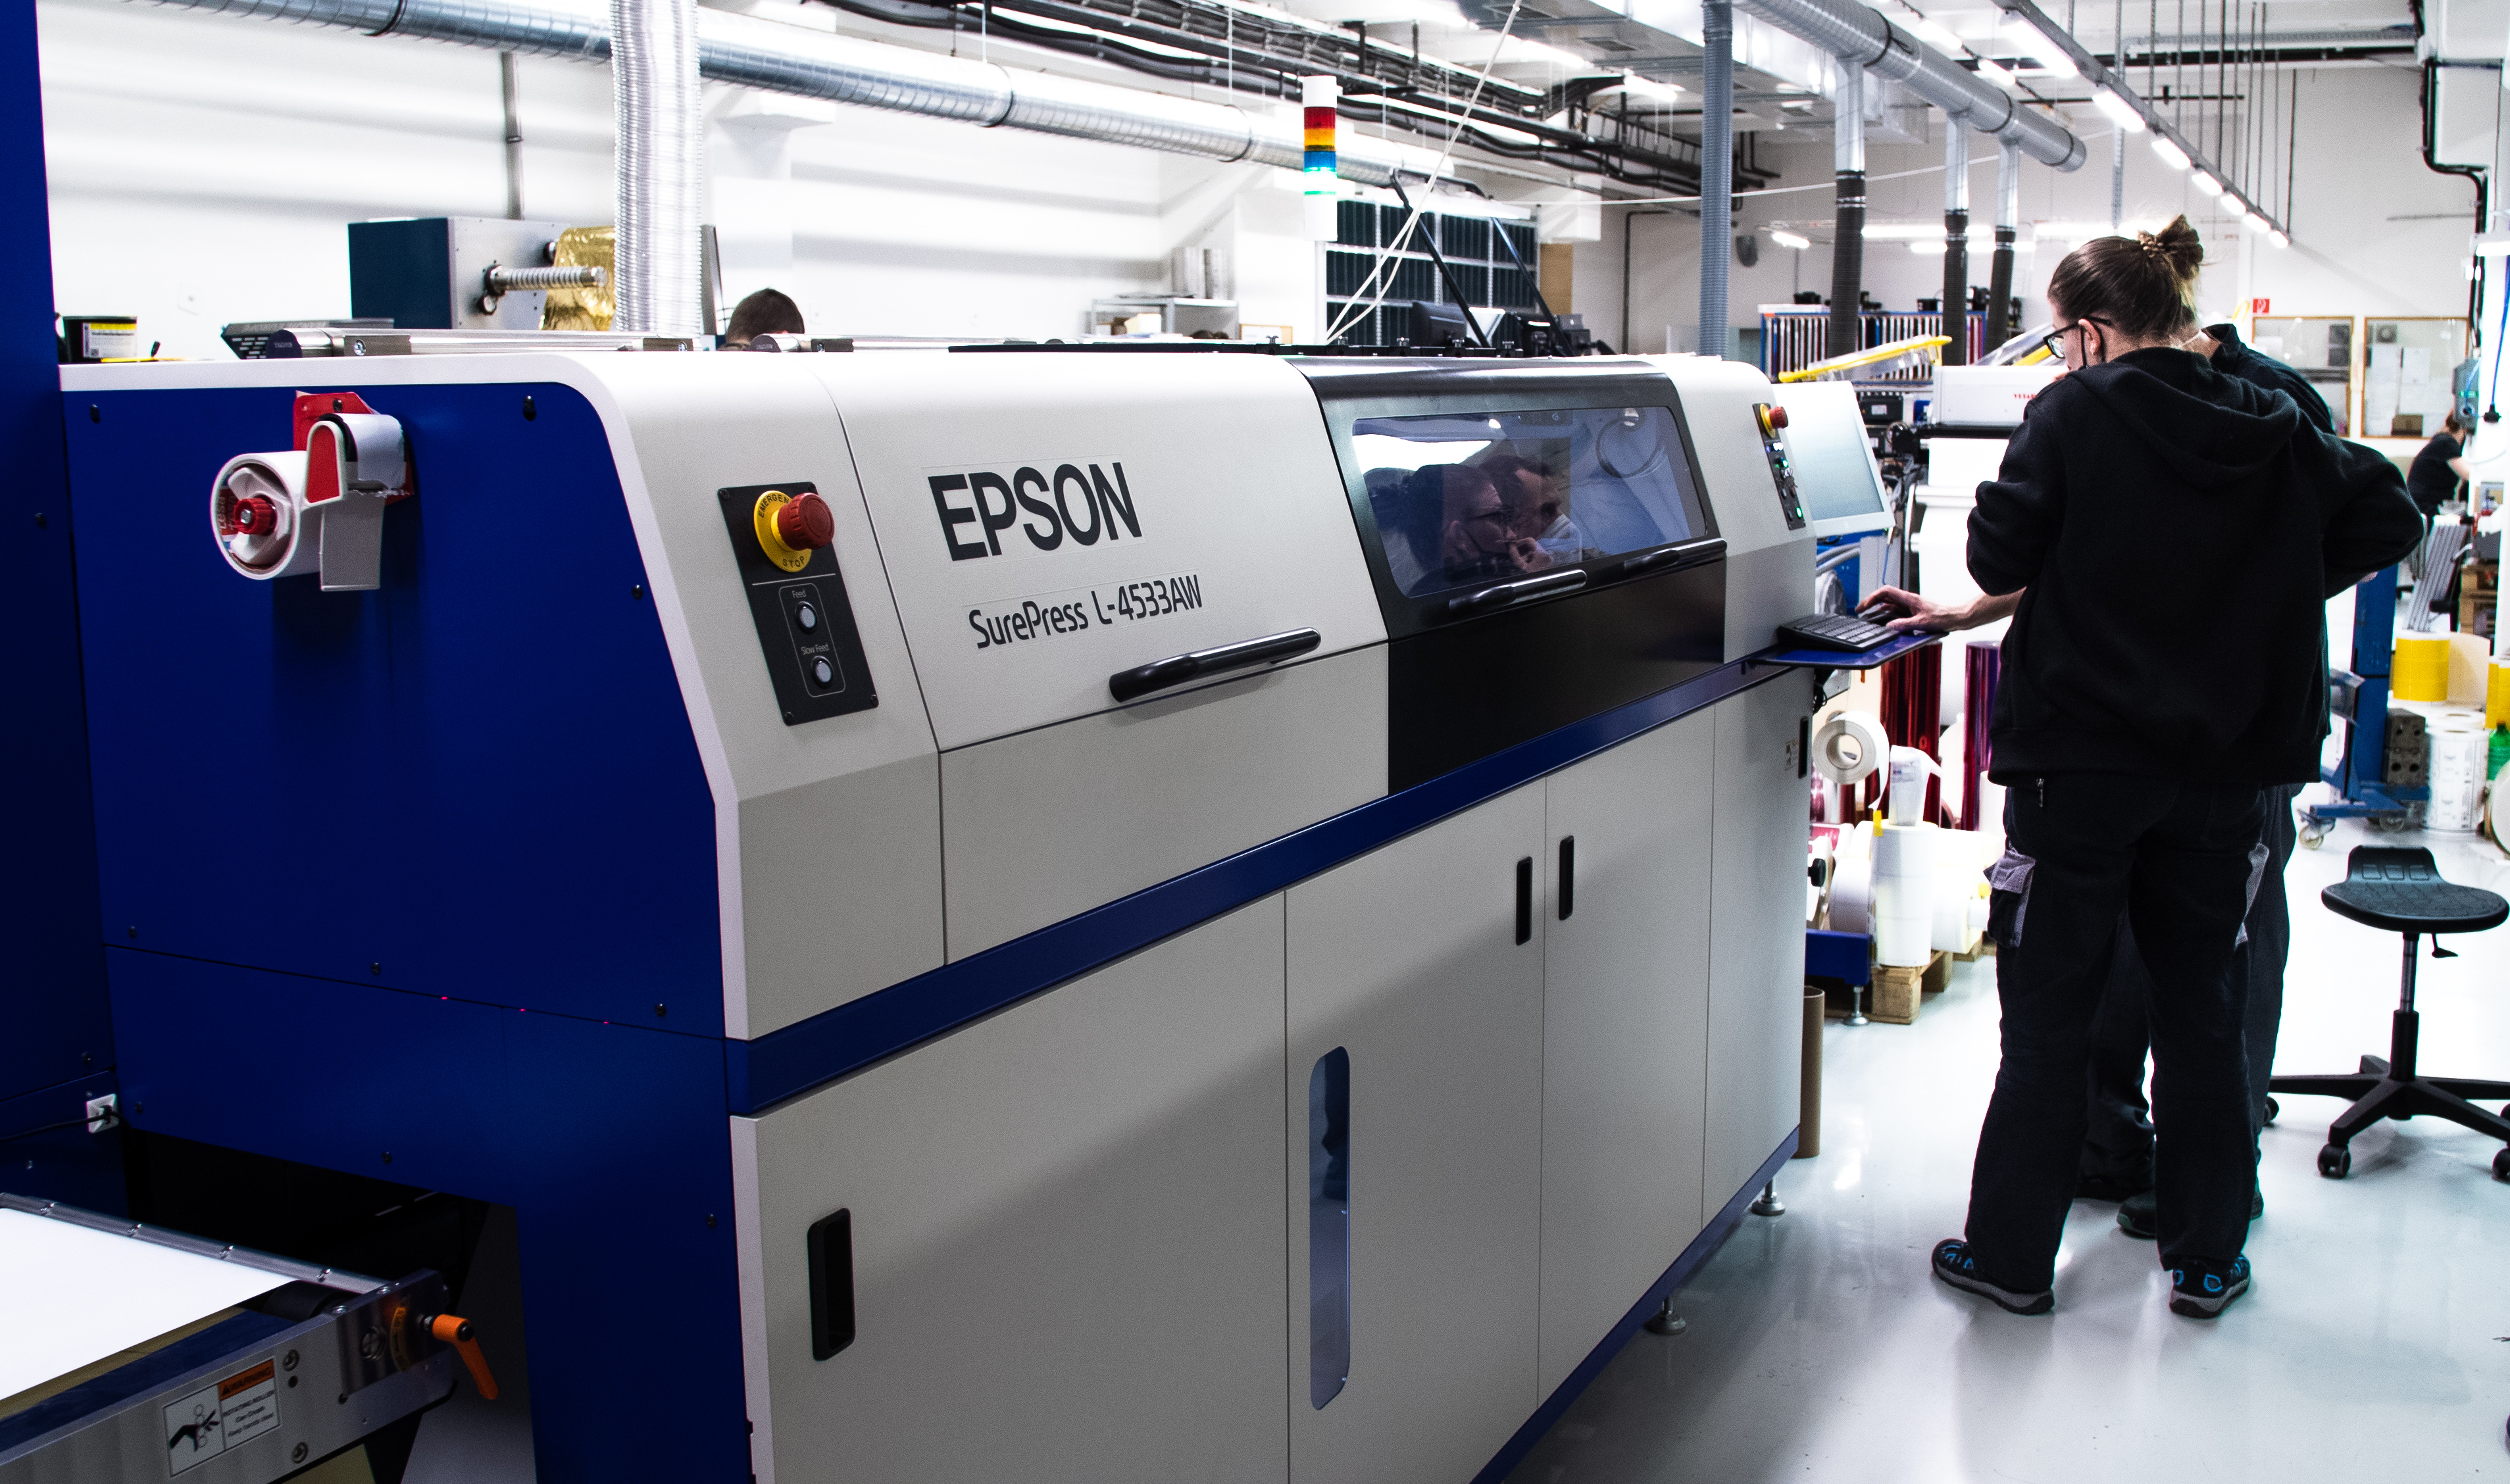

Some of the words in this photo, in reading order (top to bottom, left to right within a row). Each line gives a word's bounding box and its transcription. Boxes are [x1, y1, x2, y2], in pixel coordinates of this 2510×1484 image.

[758, 494, 790, 518] EMERGEN
[928, 462, 1143, 561] EPSON
[782, 555, 805, 568] STOP
[791, 589, 807, 599] Feed
[969, 600, 1089, 649] SurePress
[1091, 574, 1203, 626] L-4533AW
[801, 646, 815, 655] Slow
[815, 643, 830, 653] Feed
